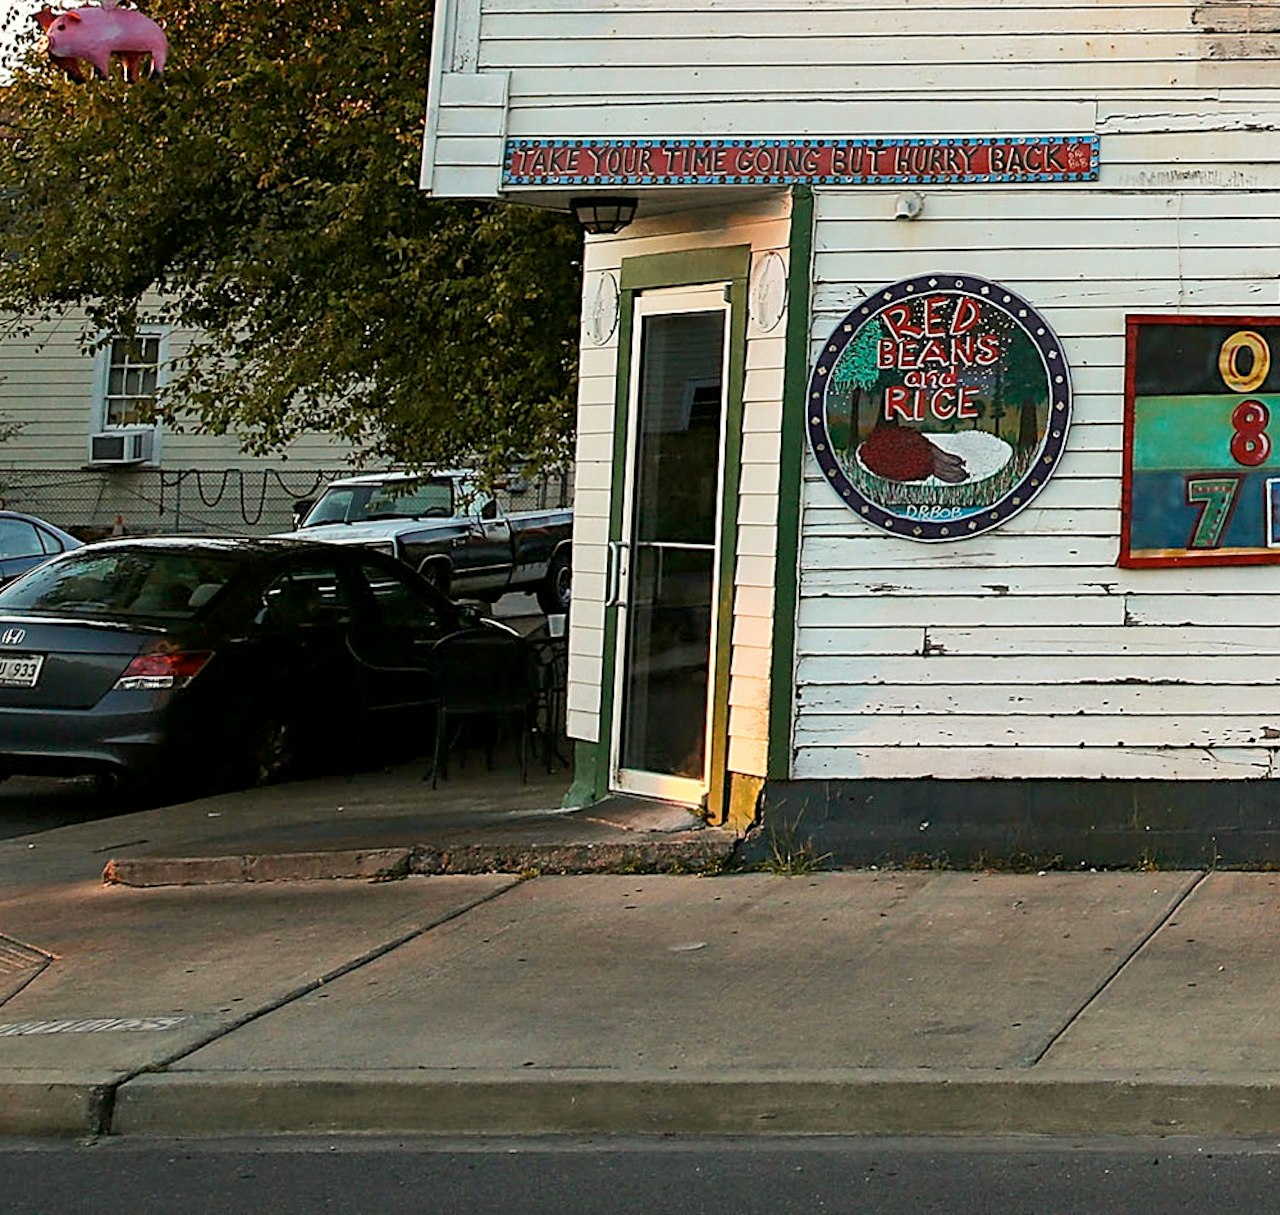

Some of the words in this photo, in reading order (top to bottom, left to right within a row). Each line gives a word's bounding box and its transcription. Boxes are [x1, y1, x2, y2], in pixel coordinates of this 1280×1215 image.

[518, 148, 581, 177] TAKE
[587, 147, 654, 176] YOUR
[662, 147, 728, 176] TIME
[735, 146, 820, 176] GOING
[831, 146, 886, 175] BUT
[894, 146, 979, 175] HURRY
[882, 296, 981, 342] RED
[877, 333, 1000, 370] BEANS
[904, 365, 958, 390] and
[885, 386, 980, 422] RICE
[1230, 399, 1271, 467] 8
[930, 505, 963, 519] BOB
[1186, 474, 1242, 551] 7
[13, 663, 37, 677] 933
